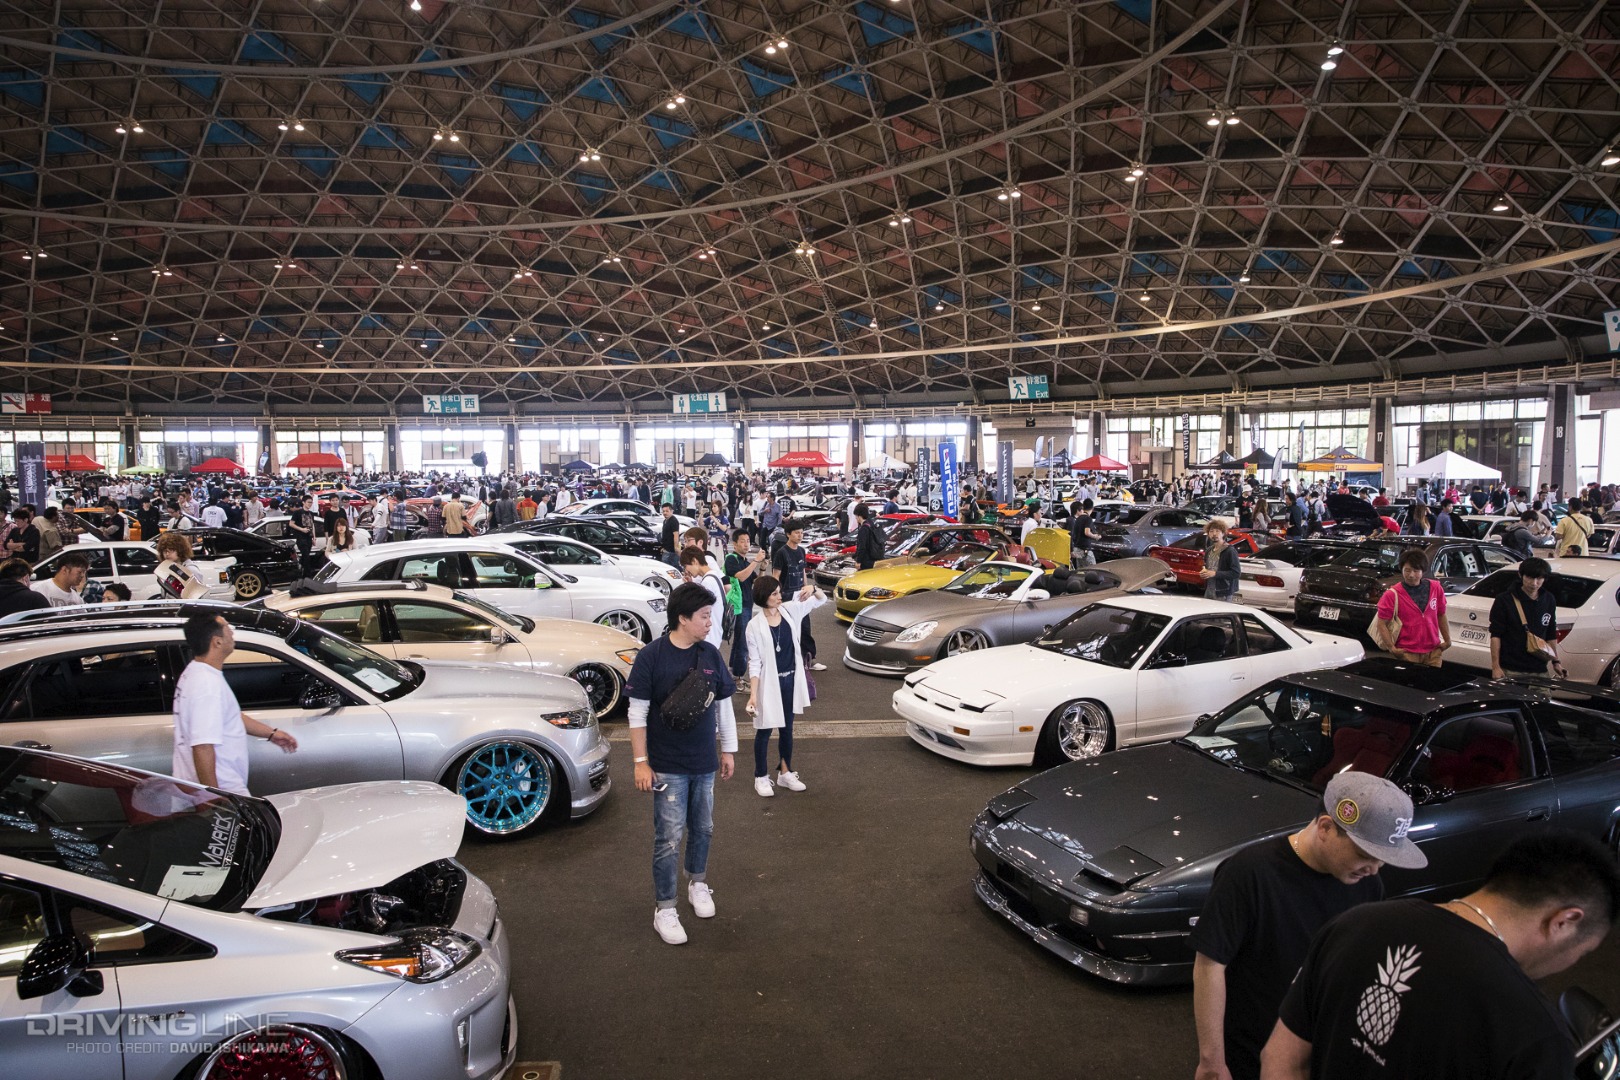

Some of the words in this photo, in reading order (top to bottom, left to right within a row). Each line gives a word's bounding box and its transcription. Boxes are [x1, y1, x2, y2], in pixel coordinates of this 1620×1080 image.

[1036, 390, 1049, 398] Exit
[465, 398, 475, 408] 西
[1377, 432, 1383, 442] 17
[1556, 426, 1563, 438] 18
[198, 811, 233, 867] Maverick
